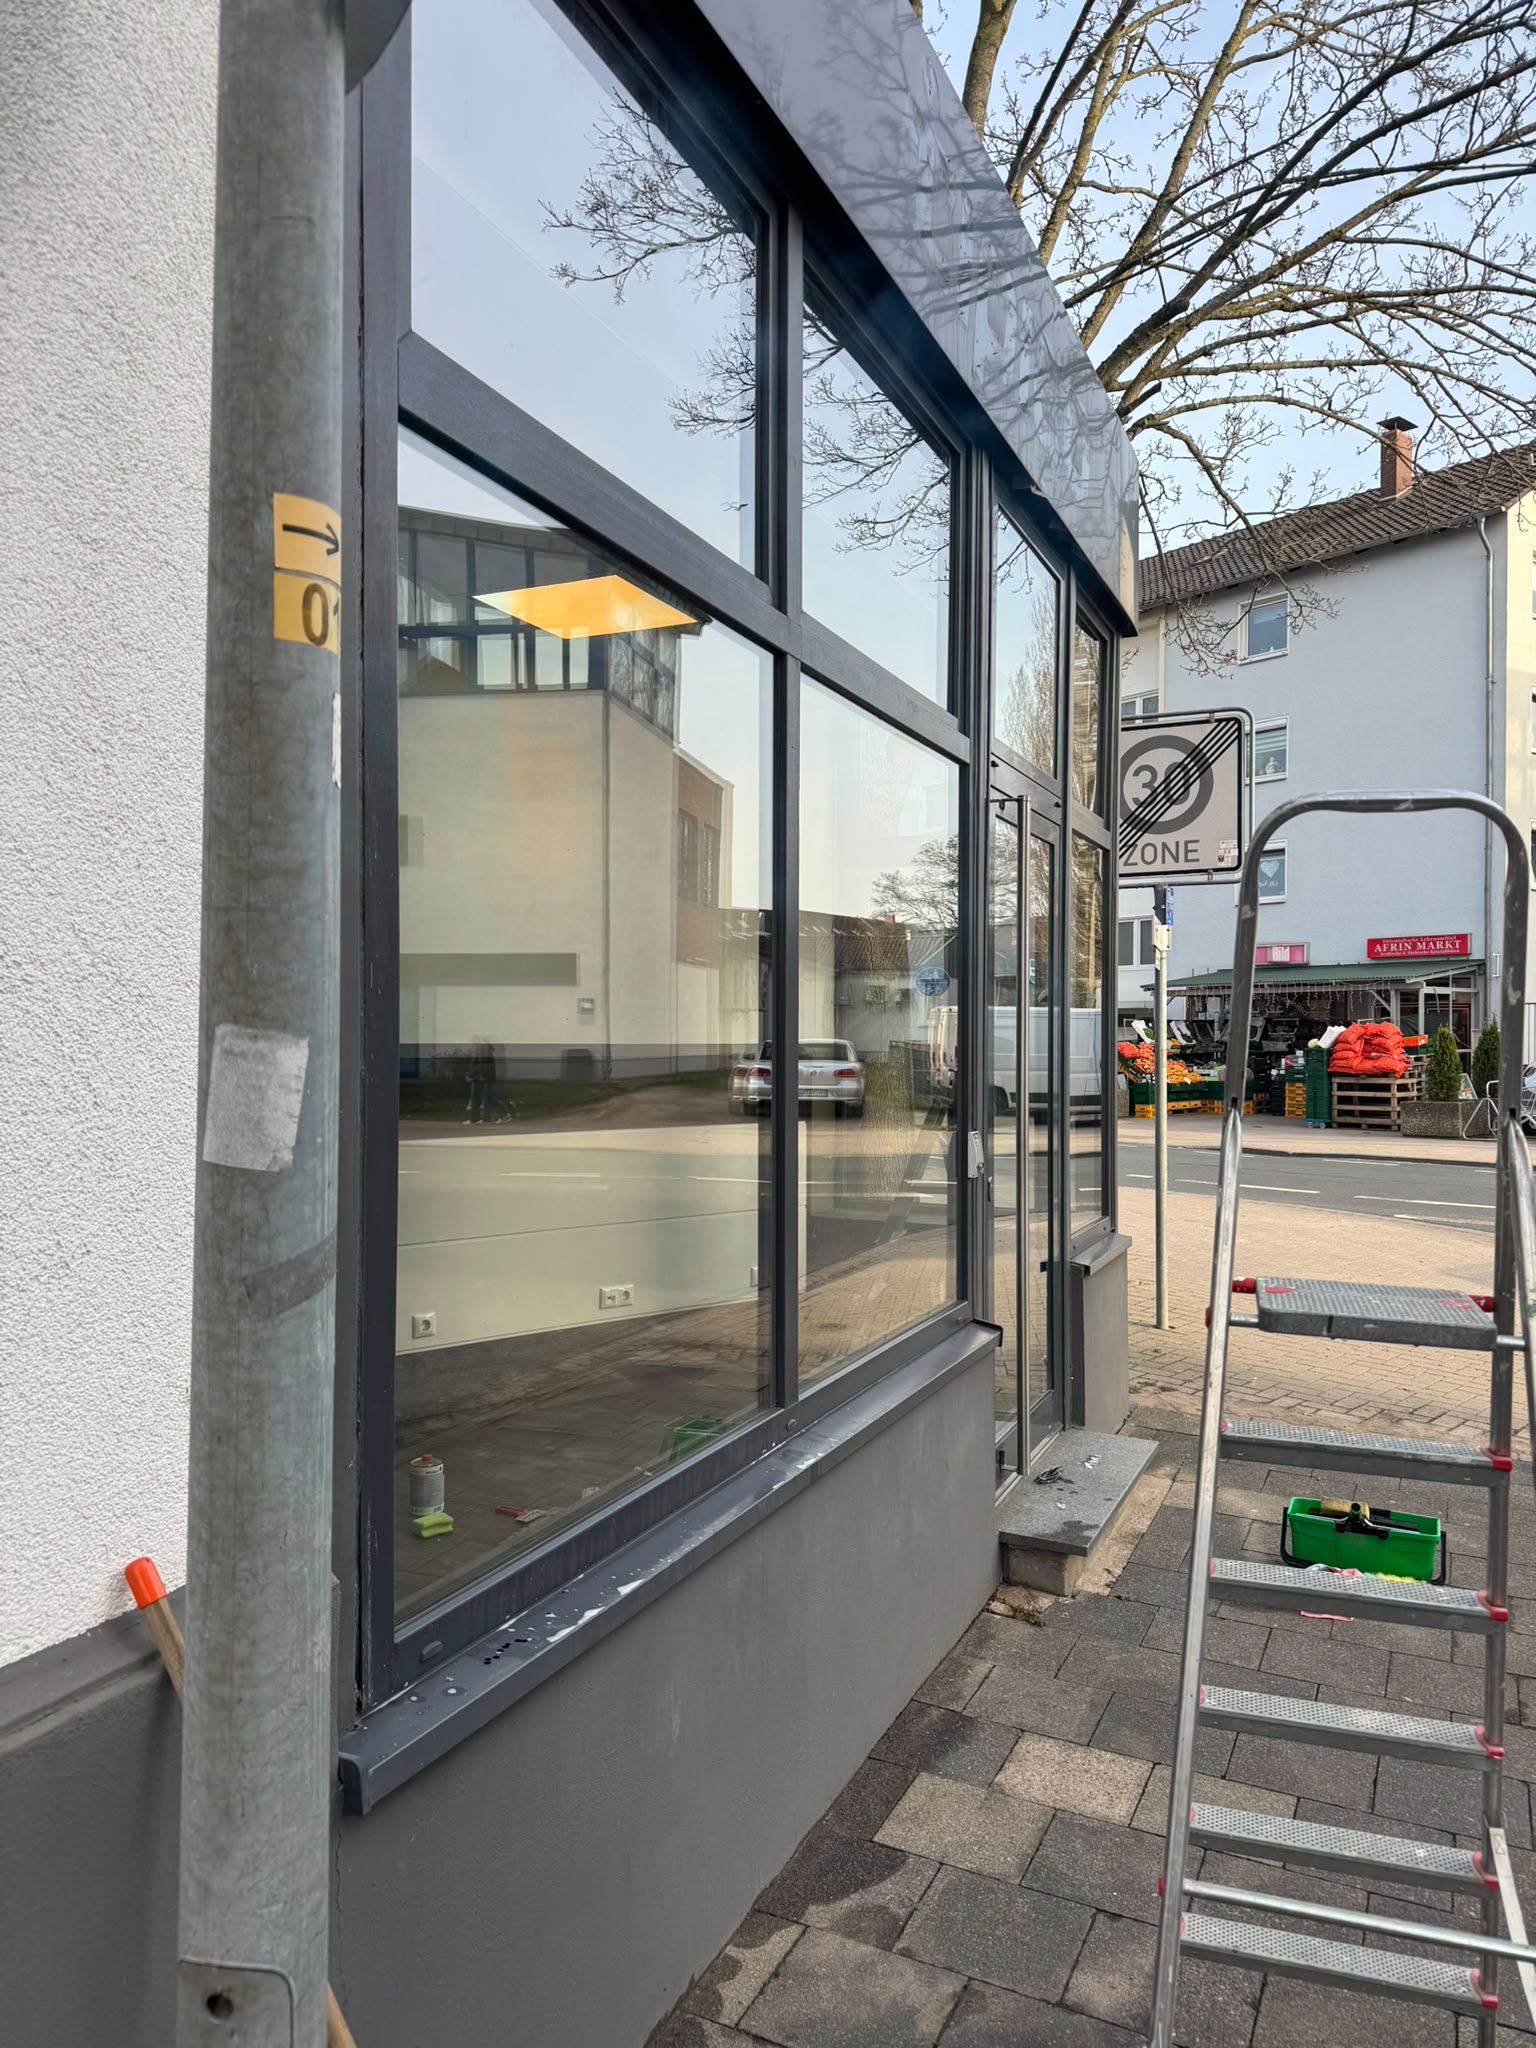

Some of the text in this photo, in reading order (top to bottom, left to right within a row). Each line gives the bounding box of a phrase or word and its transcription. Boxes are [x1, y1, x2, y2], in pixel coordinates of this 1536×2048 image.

[1132, 761, 1191, 809] 30
[1123, 839, 1200, 867] ZONE
[1272, 946, 1290, 961] Bild
[1374, 940, 1462, 952] AFRIN MARKT
